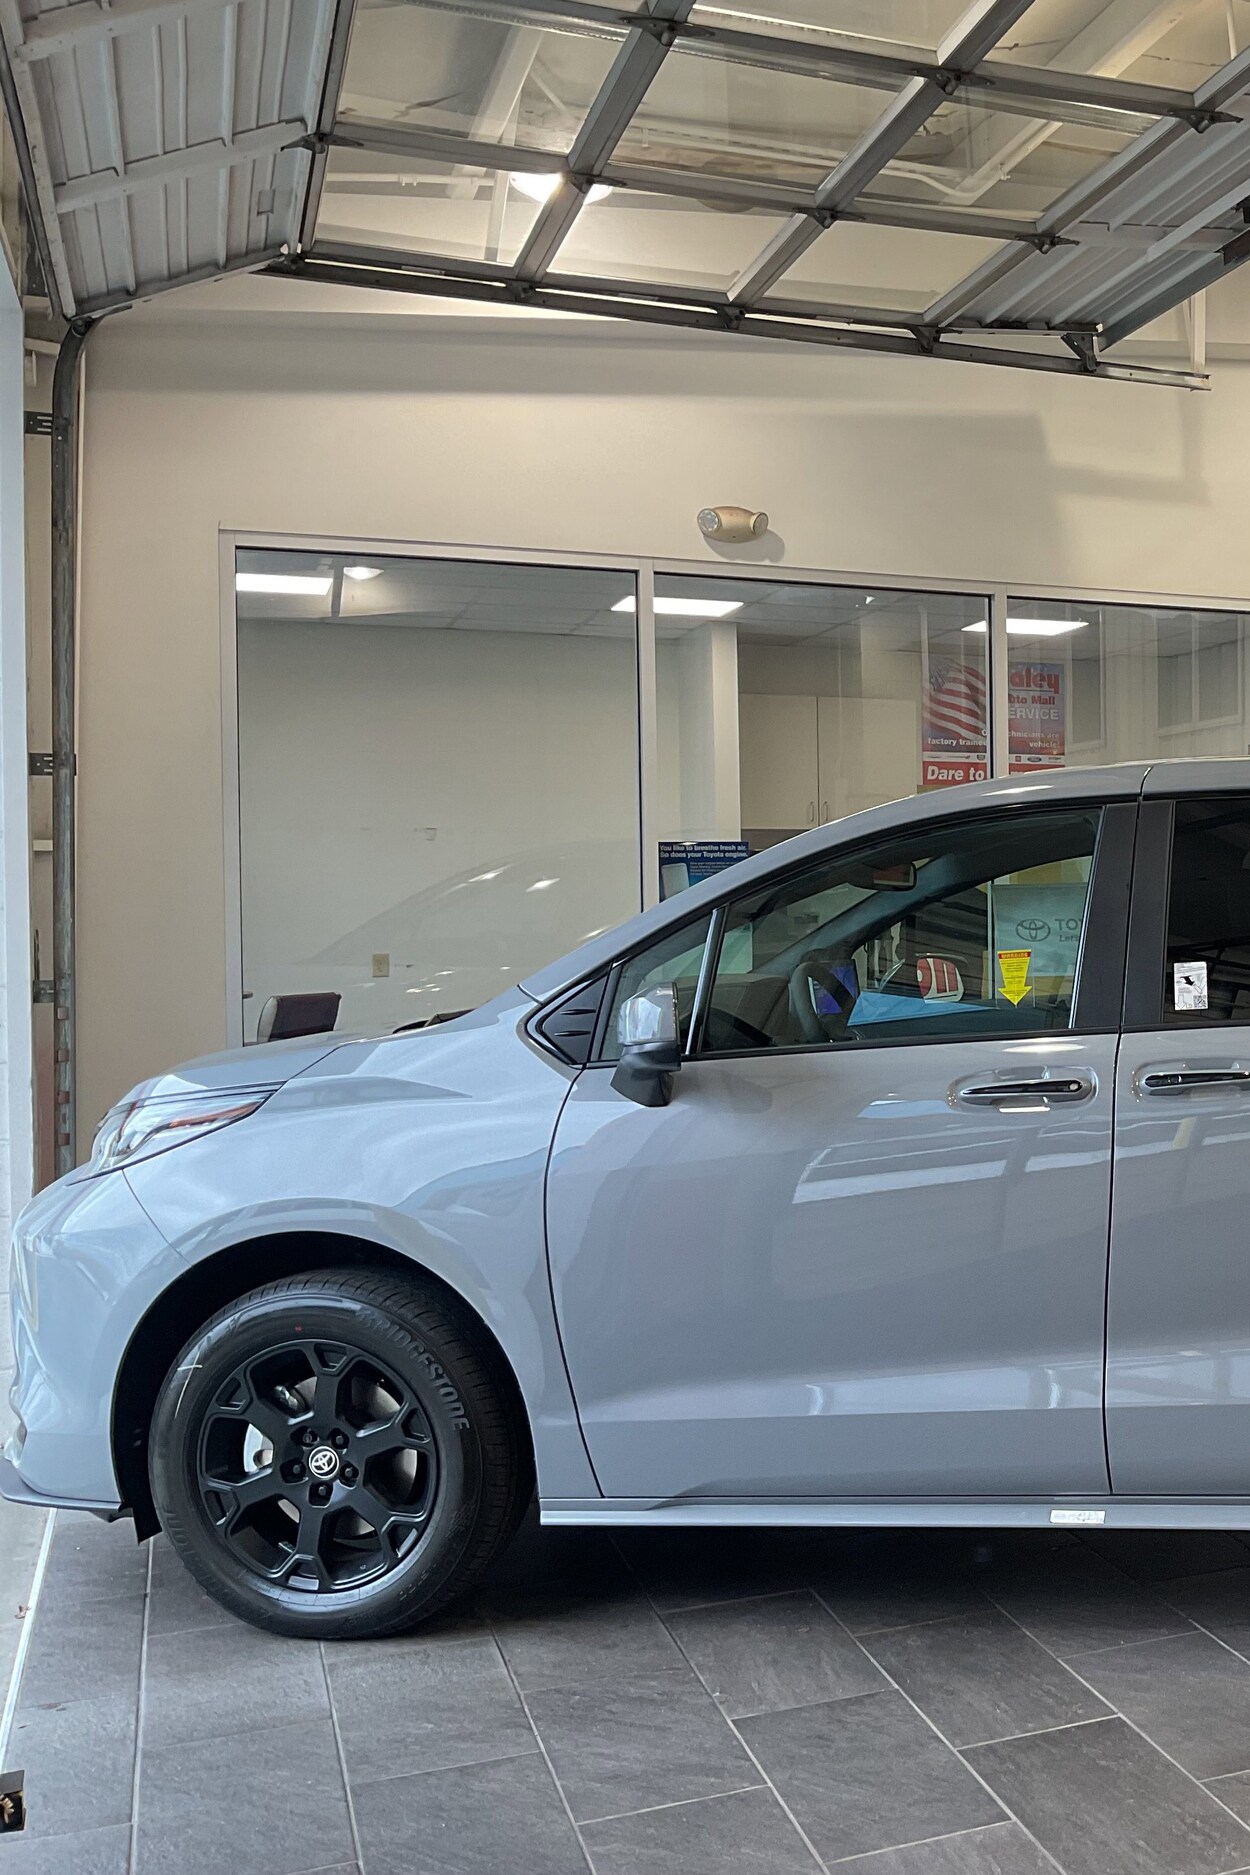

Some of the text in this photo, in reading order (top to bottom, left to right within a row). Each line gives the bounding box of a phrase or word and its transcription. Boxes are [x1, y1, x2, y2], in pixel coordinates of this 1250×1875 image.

[1031, 695, 1056, 706] Mall
[927, 737, 957, 747] factory
[927, 765, 985, 781] Dare to
[1055, 919, 1081, 931] TO
